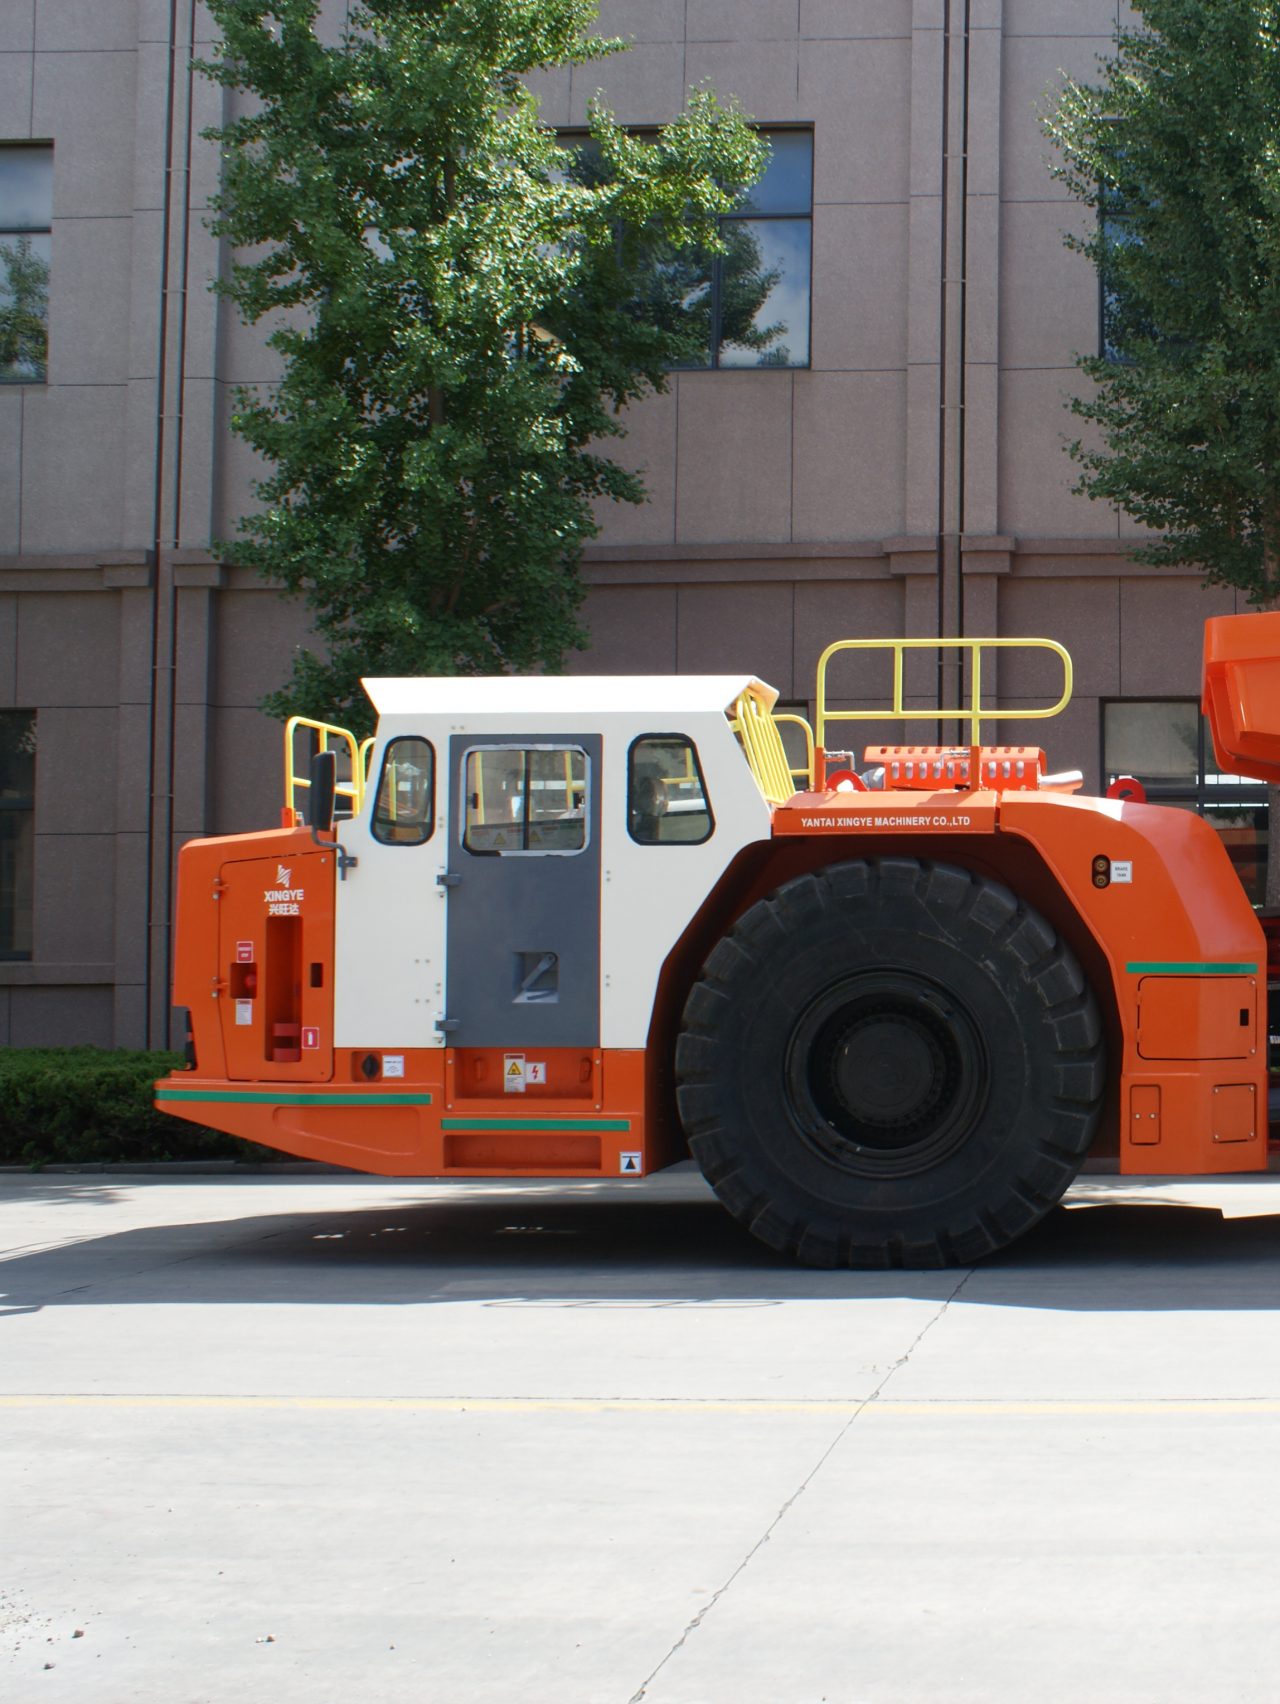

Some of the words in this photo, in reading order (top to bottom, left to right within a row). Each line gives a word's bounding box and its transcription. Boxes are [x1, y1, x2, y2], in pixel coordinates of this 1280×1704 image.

[801, 817, 835, 827] YANTAI
[837, 817, 873, 827] XINGYE
[875, 816, 931, 827] MACHINERY
[932, 816, 970, 827] CO.,LTD
[263, 889, 304, 902] XINGYE
